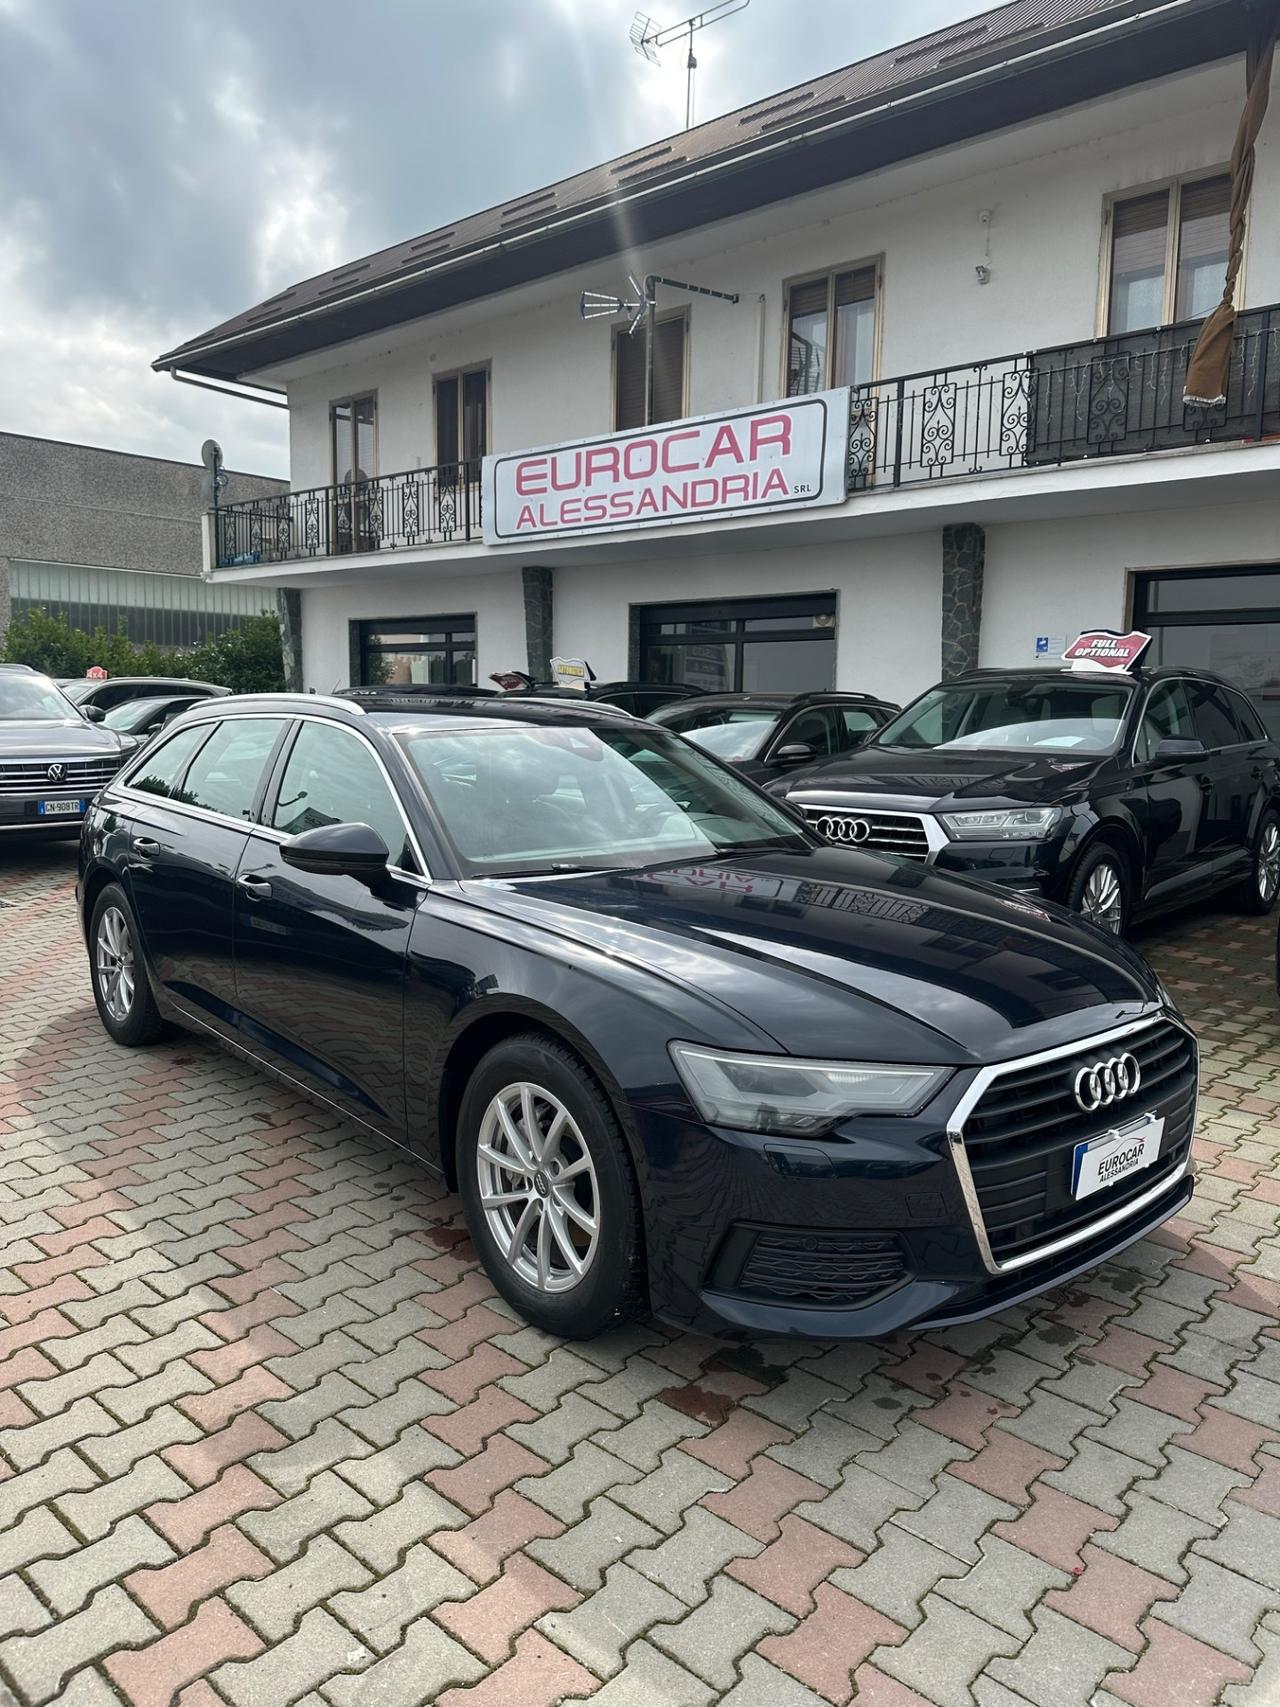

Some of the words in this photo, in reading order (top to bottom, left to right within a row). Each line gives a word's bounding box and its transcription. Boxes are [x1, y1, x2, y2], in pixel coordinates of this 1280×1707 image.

[515, 413, 792, 496] EUROCAR
[515, 468, 790, 530] ALESSANDRIA
[793, 483, 812, 495] SRL
[1074, 648, 1130, 657] OPTIONAL
[1090, 639, 1118, 648] FULL
[1097, 1142, 1145, 1176] EUROCAR
[1099, 1158, 1139, 1183] ALESSANDRIA
